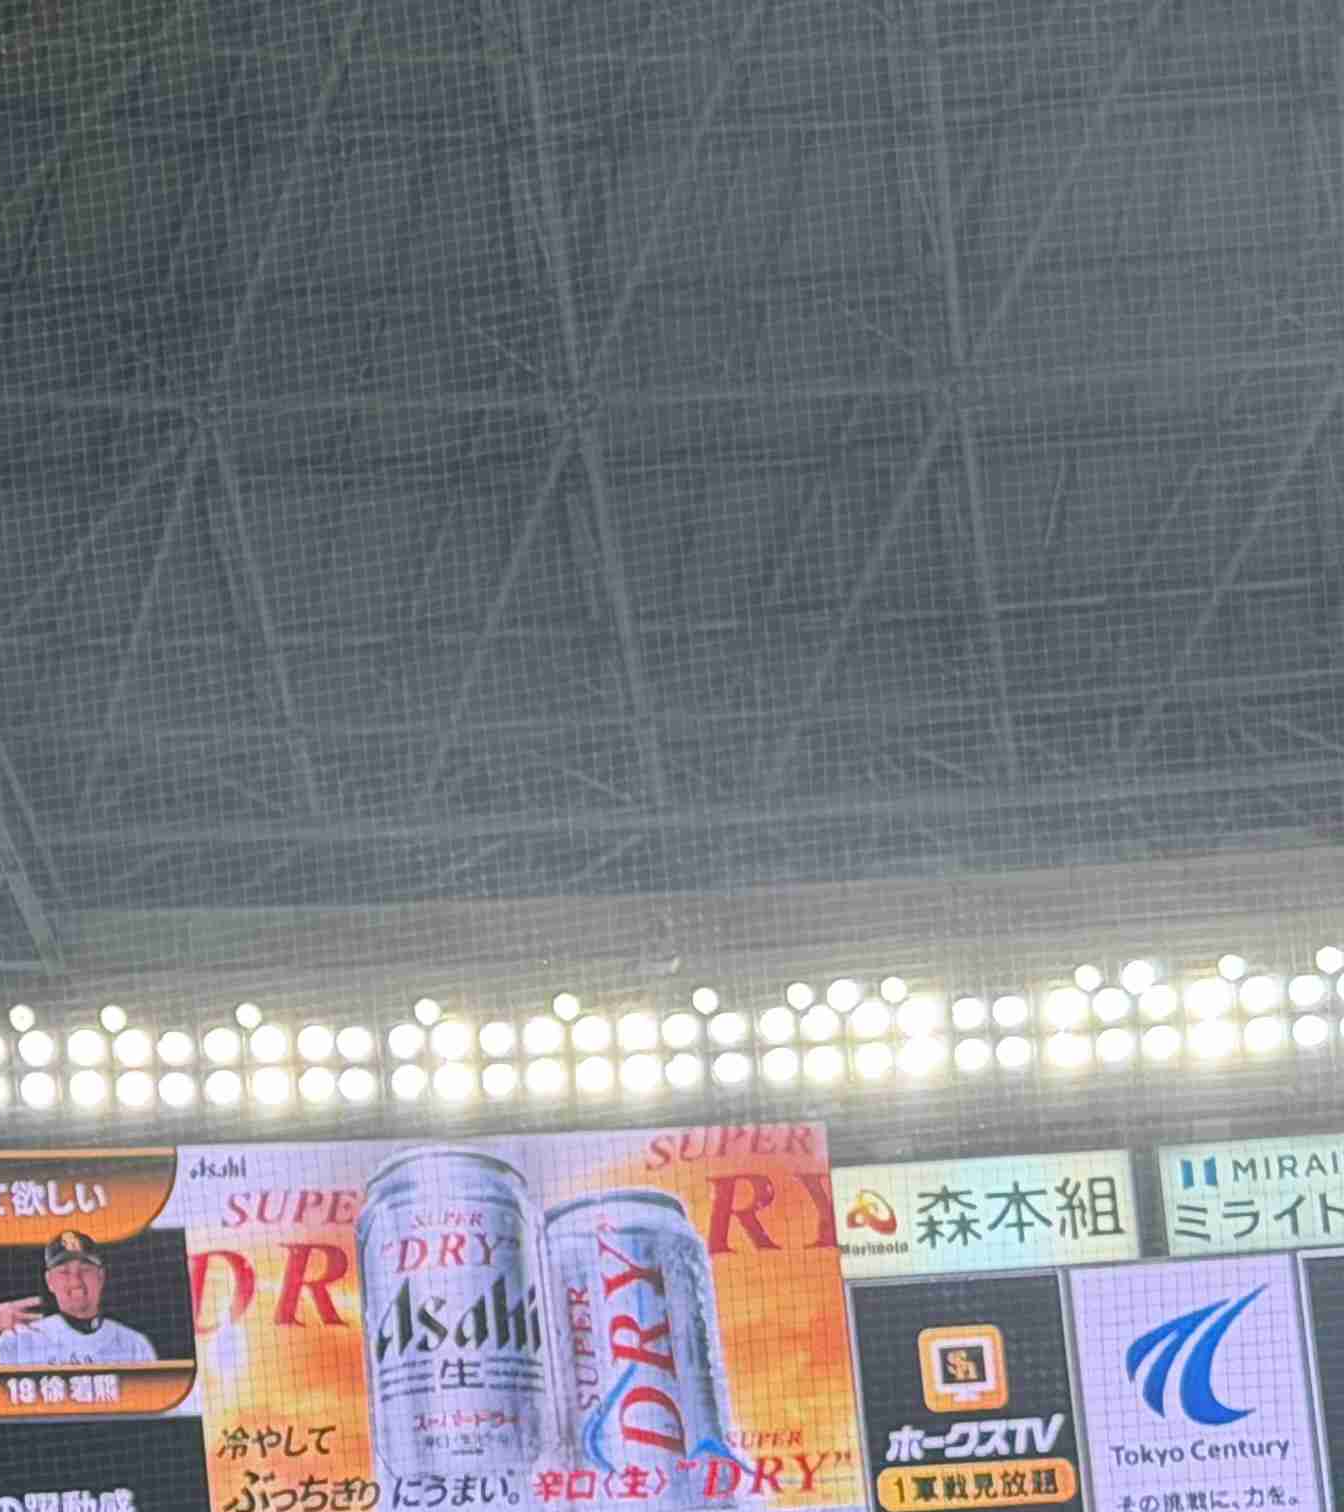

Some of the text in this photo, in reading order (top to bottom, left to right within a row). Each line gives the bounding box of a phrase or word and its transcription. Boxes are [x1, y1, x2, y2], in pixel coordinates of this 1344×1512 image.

[645, 1122, 812, 1171] SUPER
[190, 1154, 247, 1181] Asahi
[916, 1176, 1125, 1249] 森本組
[377, 1275, 542, 1361] Asahi
[567, 1285, 602, 1411] SUPER
[441, 1359, 482, 1390] 生
[217, 1425, 337, 1460] 冷やして
[726, 1430, 802, 1449] SUPER
[886, 1413, 1065, 1463] ホークスTV
[1111, 1436, 1290, 1467] Tokyo Century
[894, 1467, 1059, 1504] 1軍戦見放題
